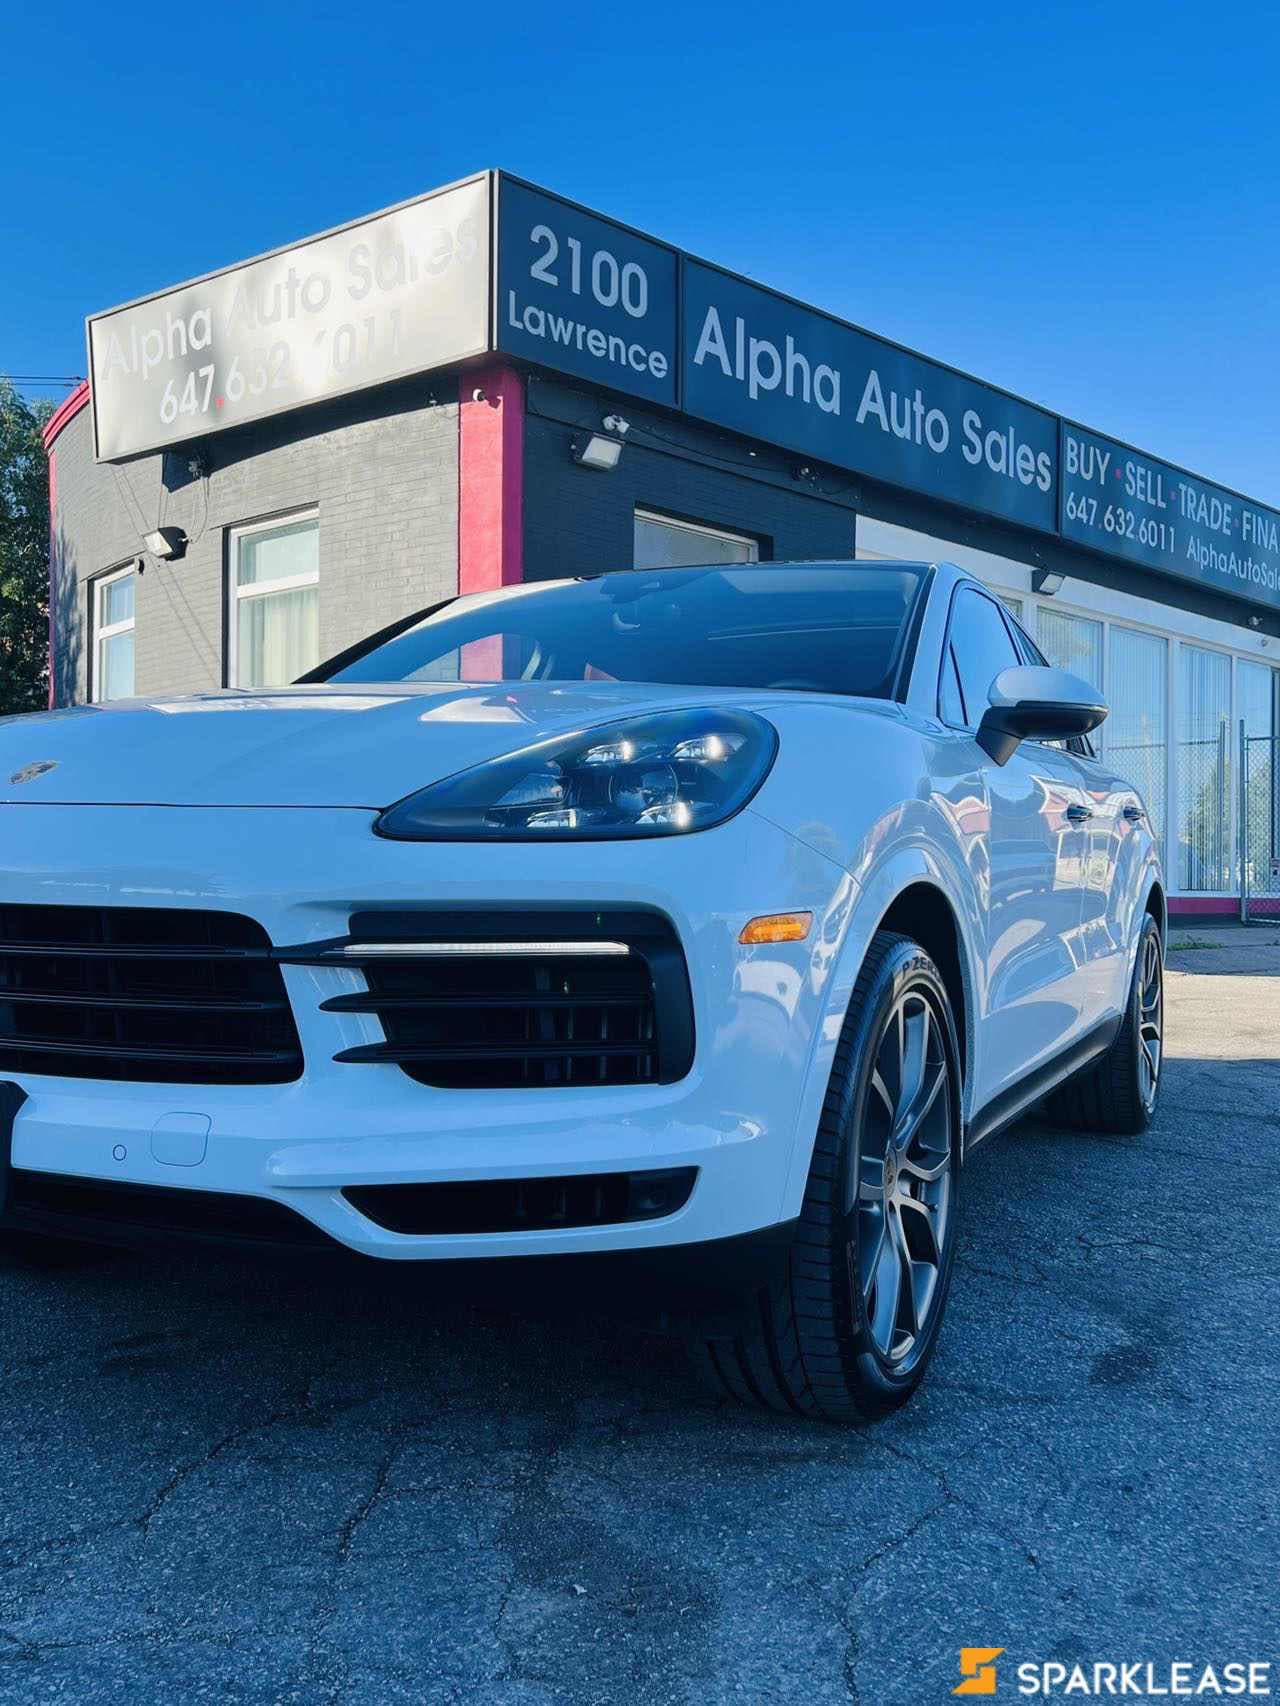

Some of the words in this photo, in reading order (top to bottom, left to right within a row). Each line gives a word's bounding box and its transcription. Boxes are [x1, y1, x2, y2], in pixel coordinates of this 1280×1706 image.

[529, 224, 648, 318] 2100
[101, 306, 214, 383] Alpha
[224, 265, 333, 336] Auto
[508, 290, 668, 379] Lawrence
[693, 305, 841, 416] Alpha
[855, 369, 950, 454] Auto
[961, 409, 1052, 493] Sales
[1066, 436, 1111, 485] BUY
[1125, 460, 1167, 509] SELL
[1178, 482, 1232, 536] TRADE
